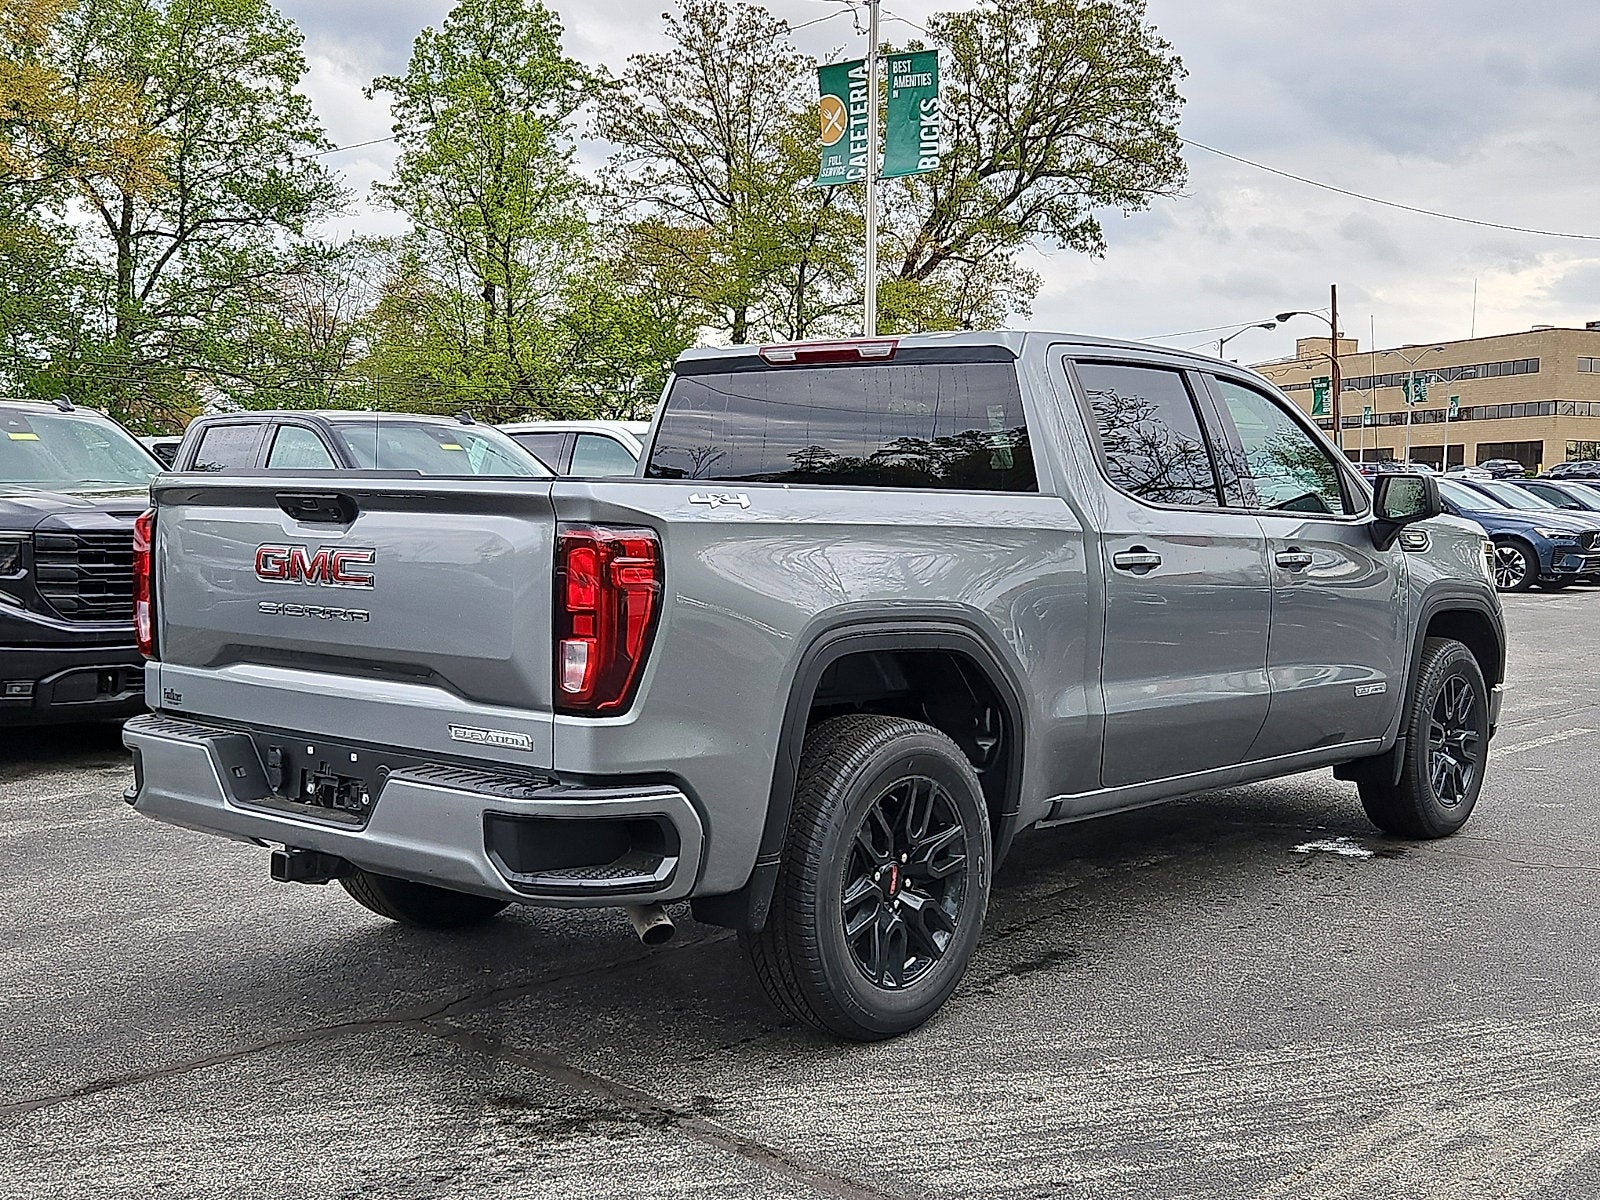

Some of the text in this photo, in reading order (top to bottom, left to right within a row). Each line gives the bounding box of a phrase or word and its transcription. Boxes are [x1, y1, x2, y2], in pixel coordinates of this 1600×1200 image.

[892, 59, 912, 74] BEST
[892, 72, 932, 88] AMENITIES
[845, 60, 869, 180] CAFETERIA
[917, 97, 941, 170] BUCKS
[821, 165, 847, 178] SERVICE
[827, 154, 843, 167] FULL
[255, 541, 376, 591] GMC
[258, 600, 371, 623] SIERRA
[450, 725, 532, 749] ELEVATION
